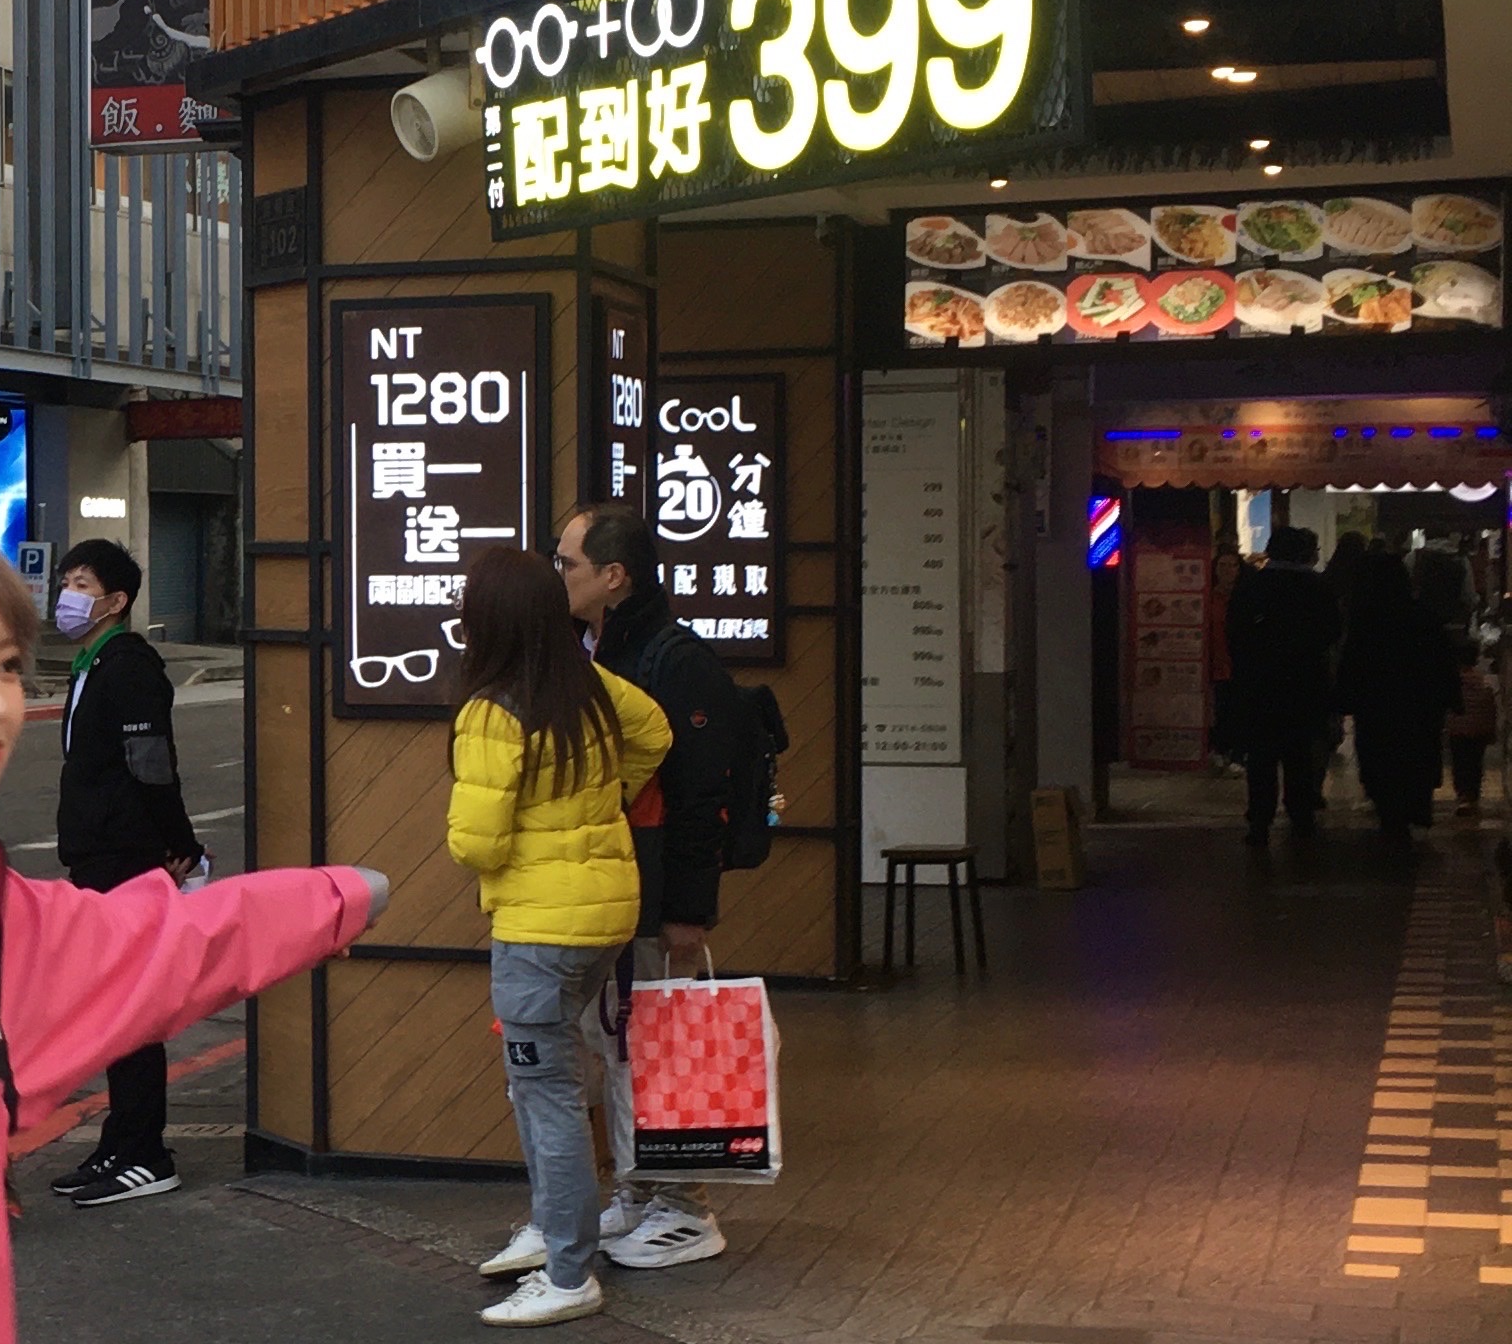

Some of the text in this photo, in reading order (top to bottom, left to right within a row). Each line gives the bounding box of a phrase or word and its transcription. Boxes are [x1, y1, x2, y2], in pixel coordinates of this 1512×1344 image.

[513, 60, 711, 209] 配到好
[371, 327, 423, 359] NT
[612, 328, 626, 359] NT
[370, 371, 511, 426] 1280
[612, 373, 643, 428] 1280
[372, 442, 483, 500] 買一
[658, 453, 772, 540] 20 分鐘
[25, 550, 40, 573] P
[404, 506, 516, 563] 送一
